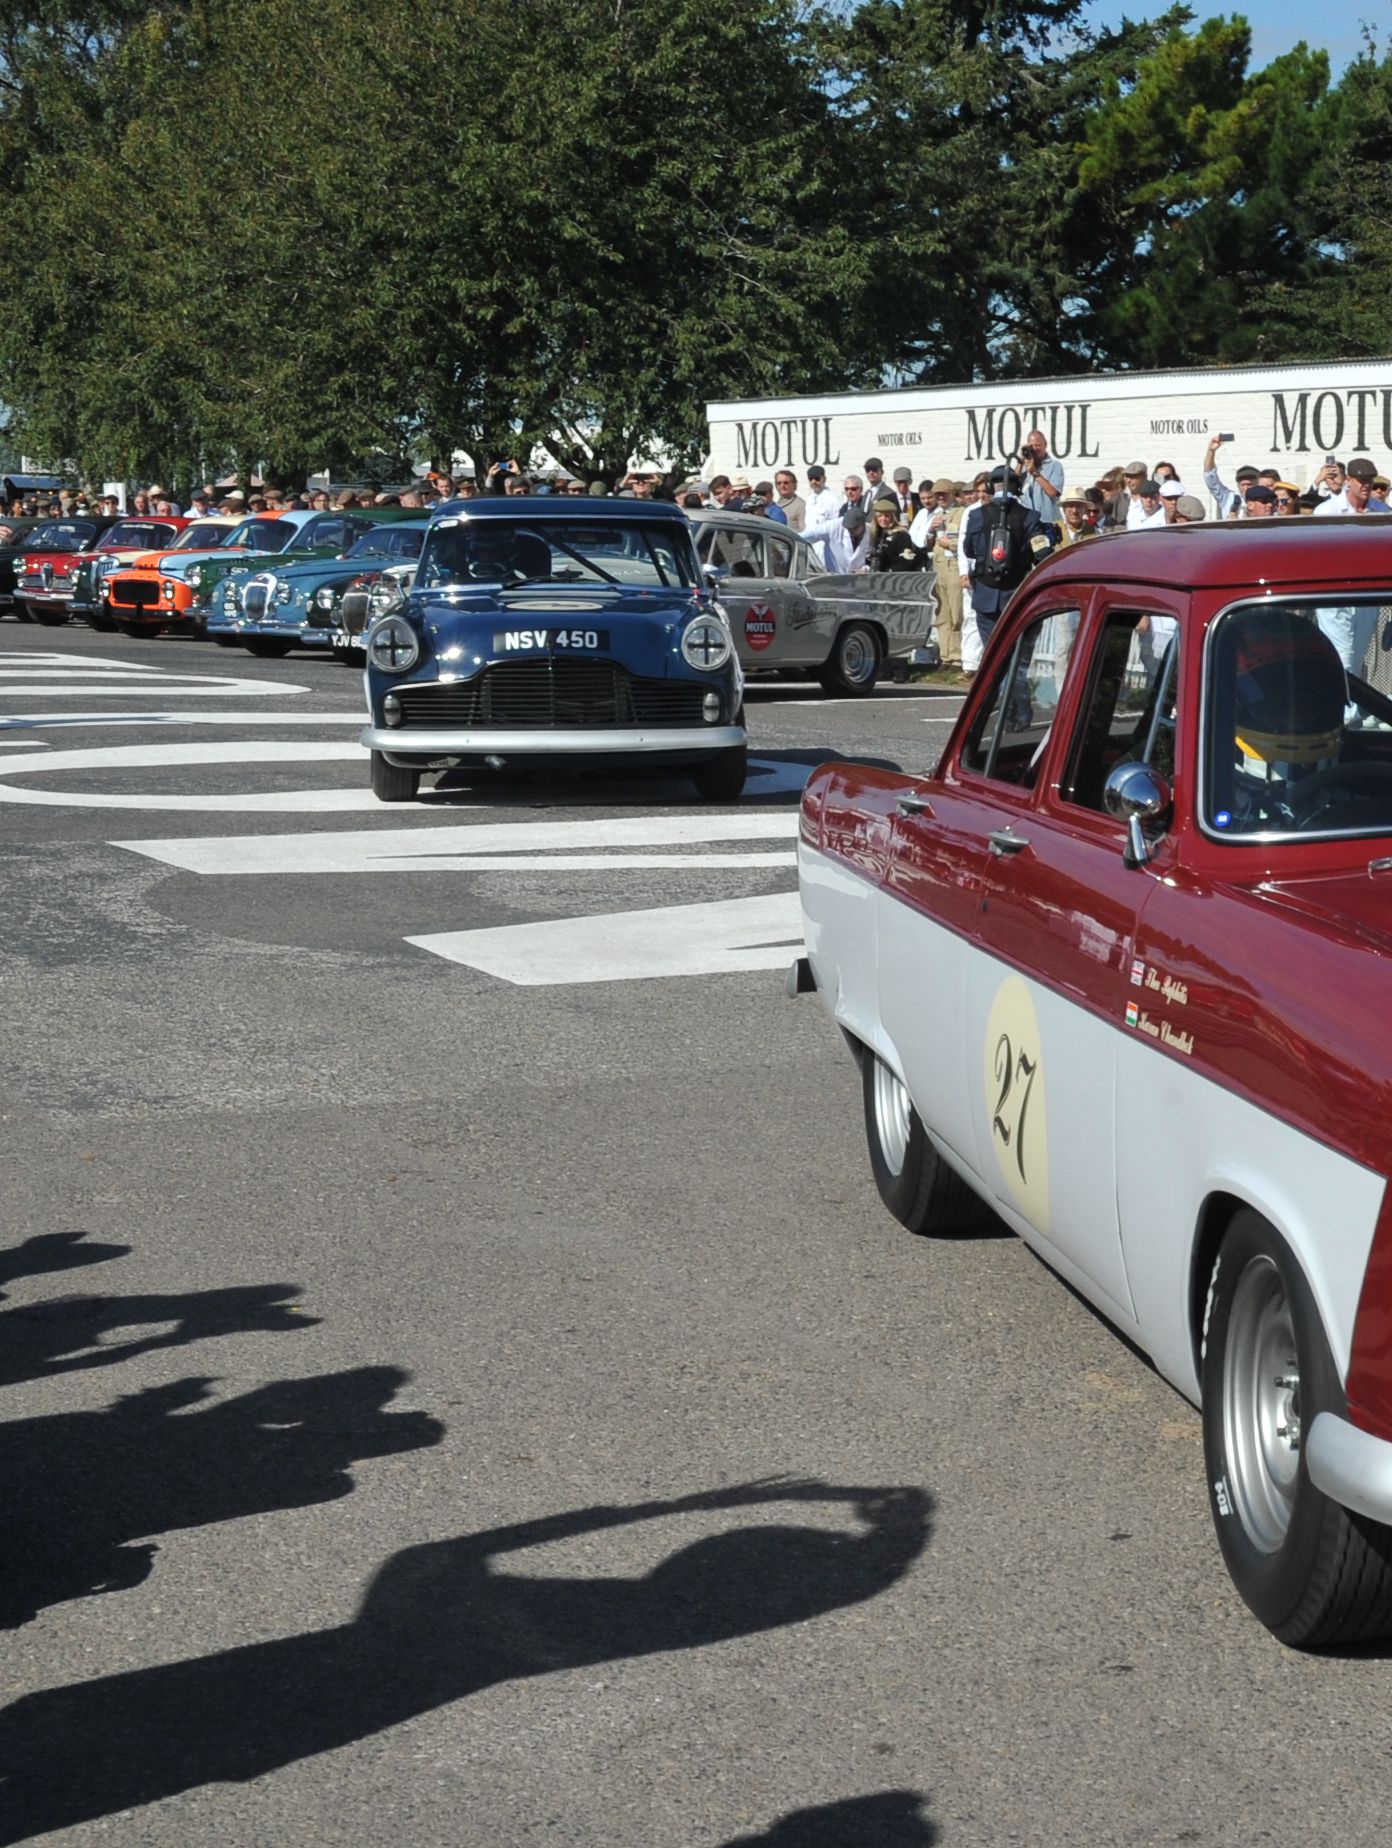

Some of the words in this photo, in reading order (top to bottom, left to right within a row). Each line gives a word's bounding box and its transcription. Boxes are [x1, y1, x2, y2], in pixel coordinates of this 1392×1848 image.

[964, 404, 1100, 461] MOTUL
[1150, 420, 1185, 434] MOTOR
[1187, 419, 1208, 433] OILS
[735, 417, 840, 468] MOTUL
[877, 433, 903, 447] MOTOR
[905, 431, 922, 445] OILS
[746, 621, 774, 633] MOTUL
[331, 635, 350, 648] YJV
[505, 630, 548, 650] NSV
[556, 630, 598, 648] 450
[993, 1033, 1037, 1185] 27
